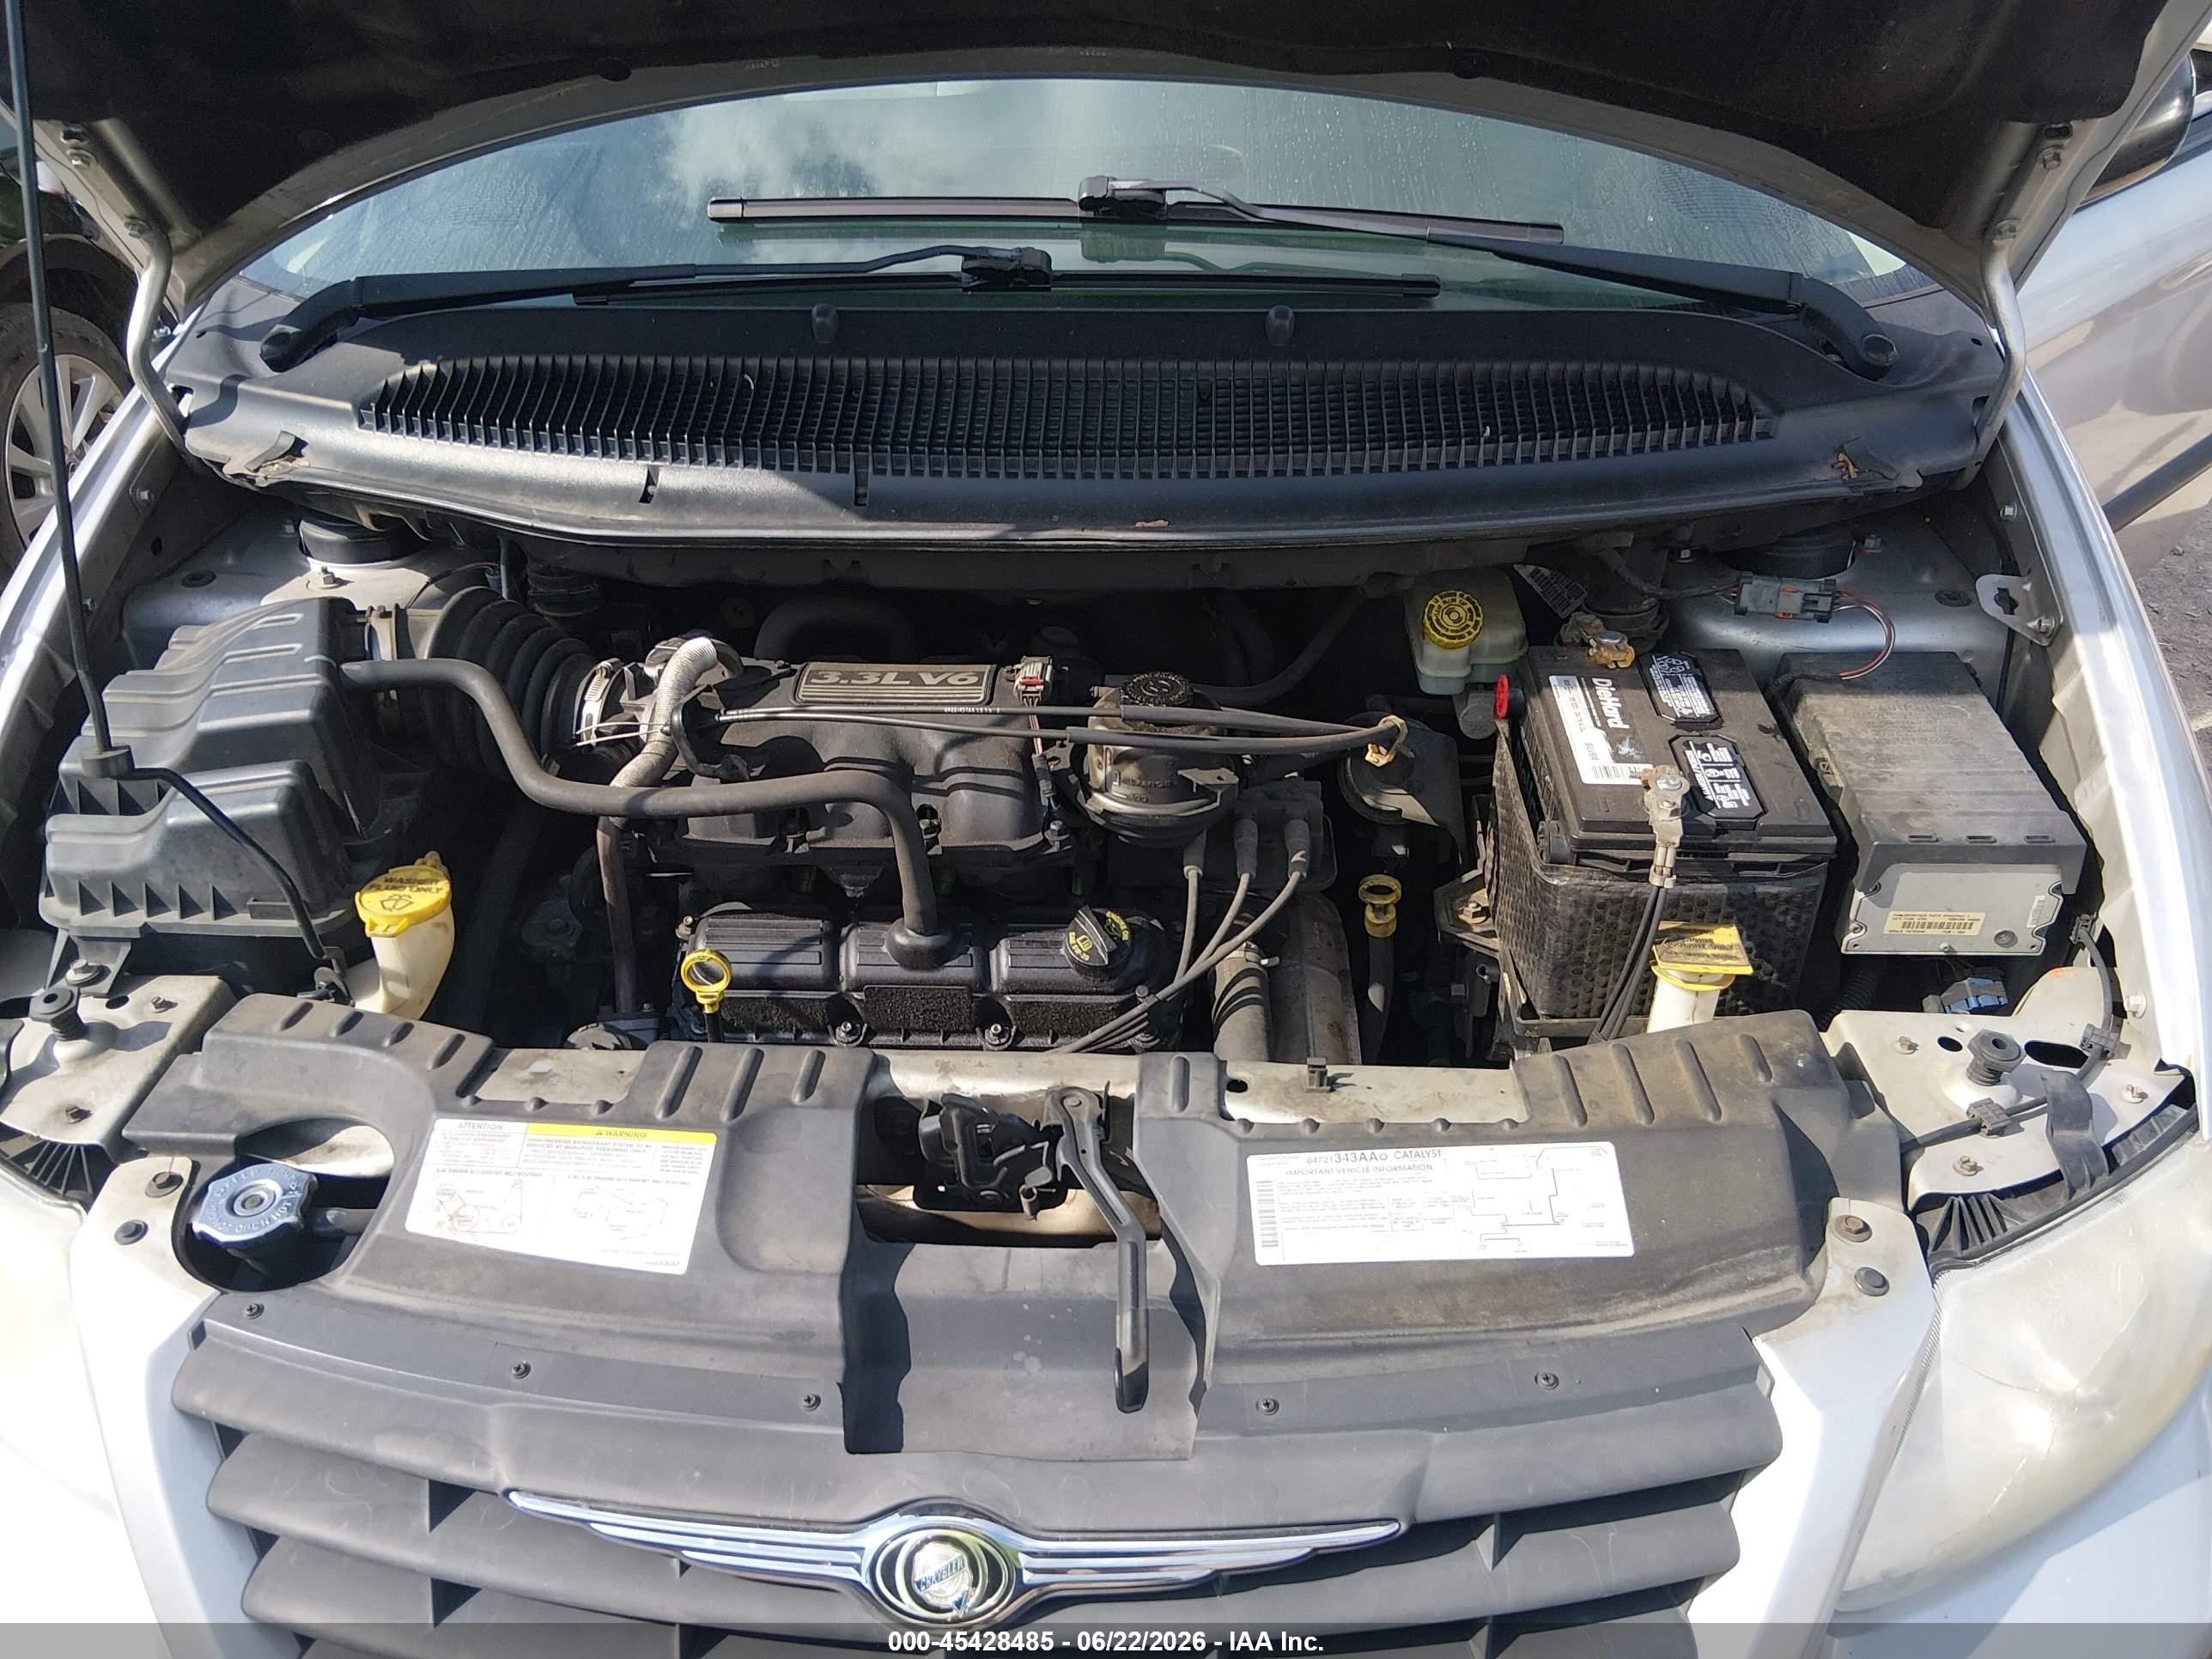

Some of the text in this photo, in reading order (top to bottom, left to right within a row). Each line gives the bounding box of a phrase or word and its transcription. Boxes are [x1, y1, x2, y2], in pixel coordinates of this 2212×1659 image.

[811, 671, 981, 685] 3.3L V6
[1591, 677, 1630, 730] DieHard
[1583, 741, 1599, 762] SILVER
[384, 876, 440, 885] WASHER
[410, 884, 443, 894] ONLY
[458, 1121, 503, 1131] ATTENTION
[606, 1130, 647, 1139] WARNING
[1394, 1149, 1443, 1160] CATALYST
[1285, 1164, 1433, 1176] IMPORTANT VEHICLE INFORMATION
[920, 1556, 967, 1591] CHRYSLER
